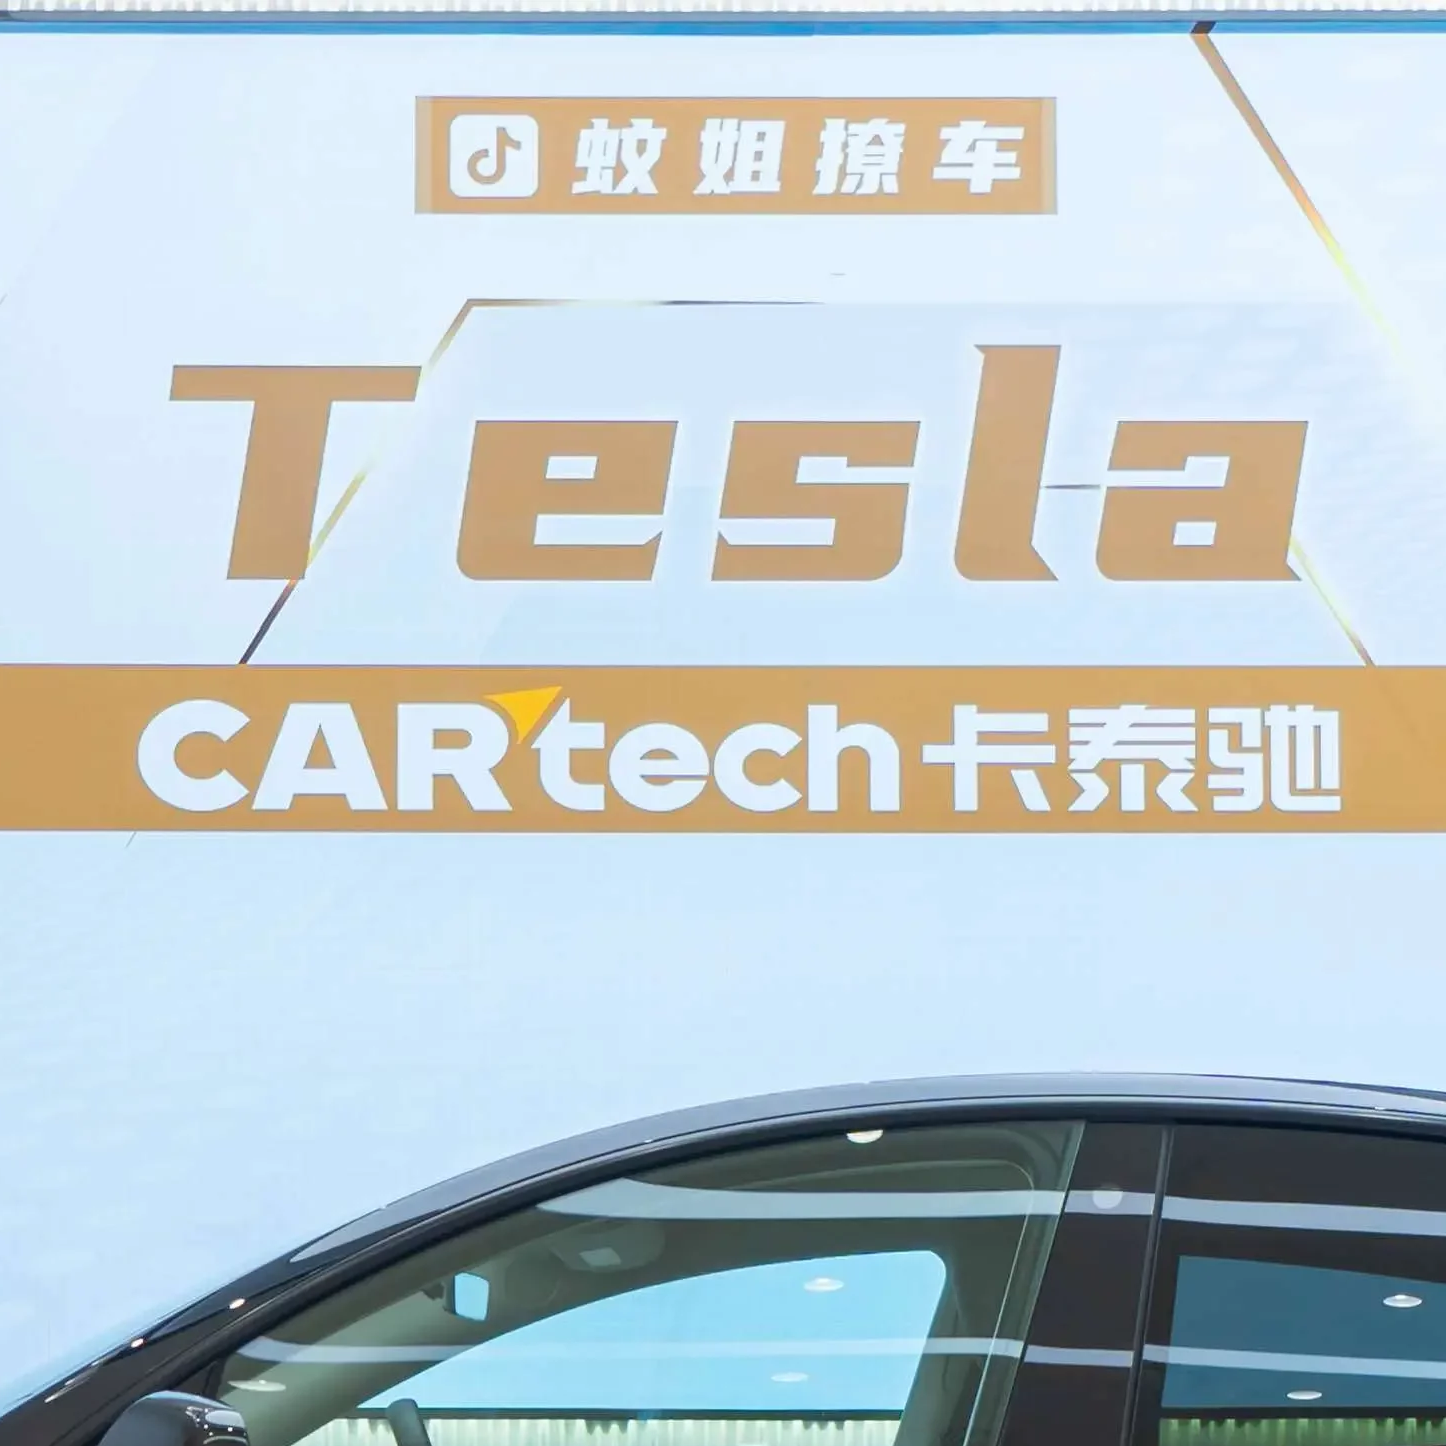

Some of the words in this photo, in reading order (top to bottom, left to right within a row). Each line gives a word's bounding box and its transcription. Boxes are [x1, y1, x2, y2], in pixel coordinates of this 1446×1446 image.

[571, 117, 1026, 196] 蚊姐撩车
[171, 345, 1308, 582] Tesla
[137, 698, 901, 813] CARtech
[921, 703, 1342, 813] 卡泰驰
